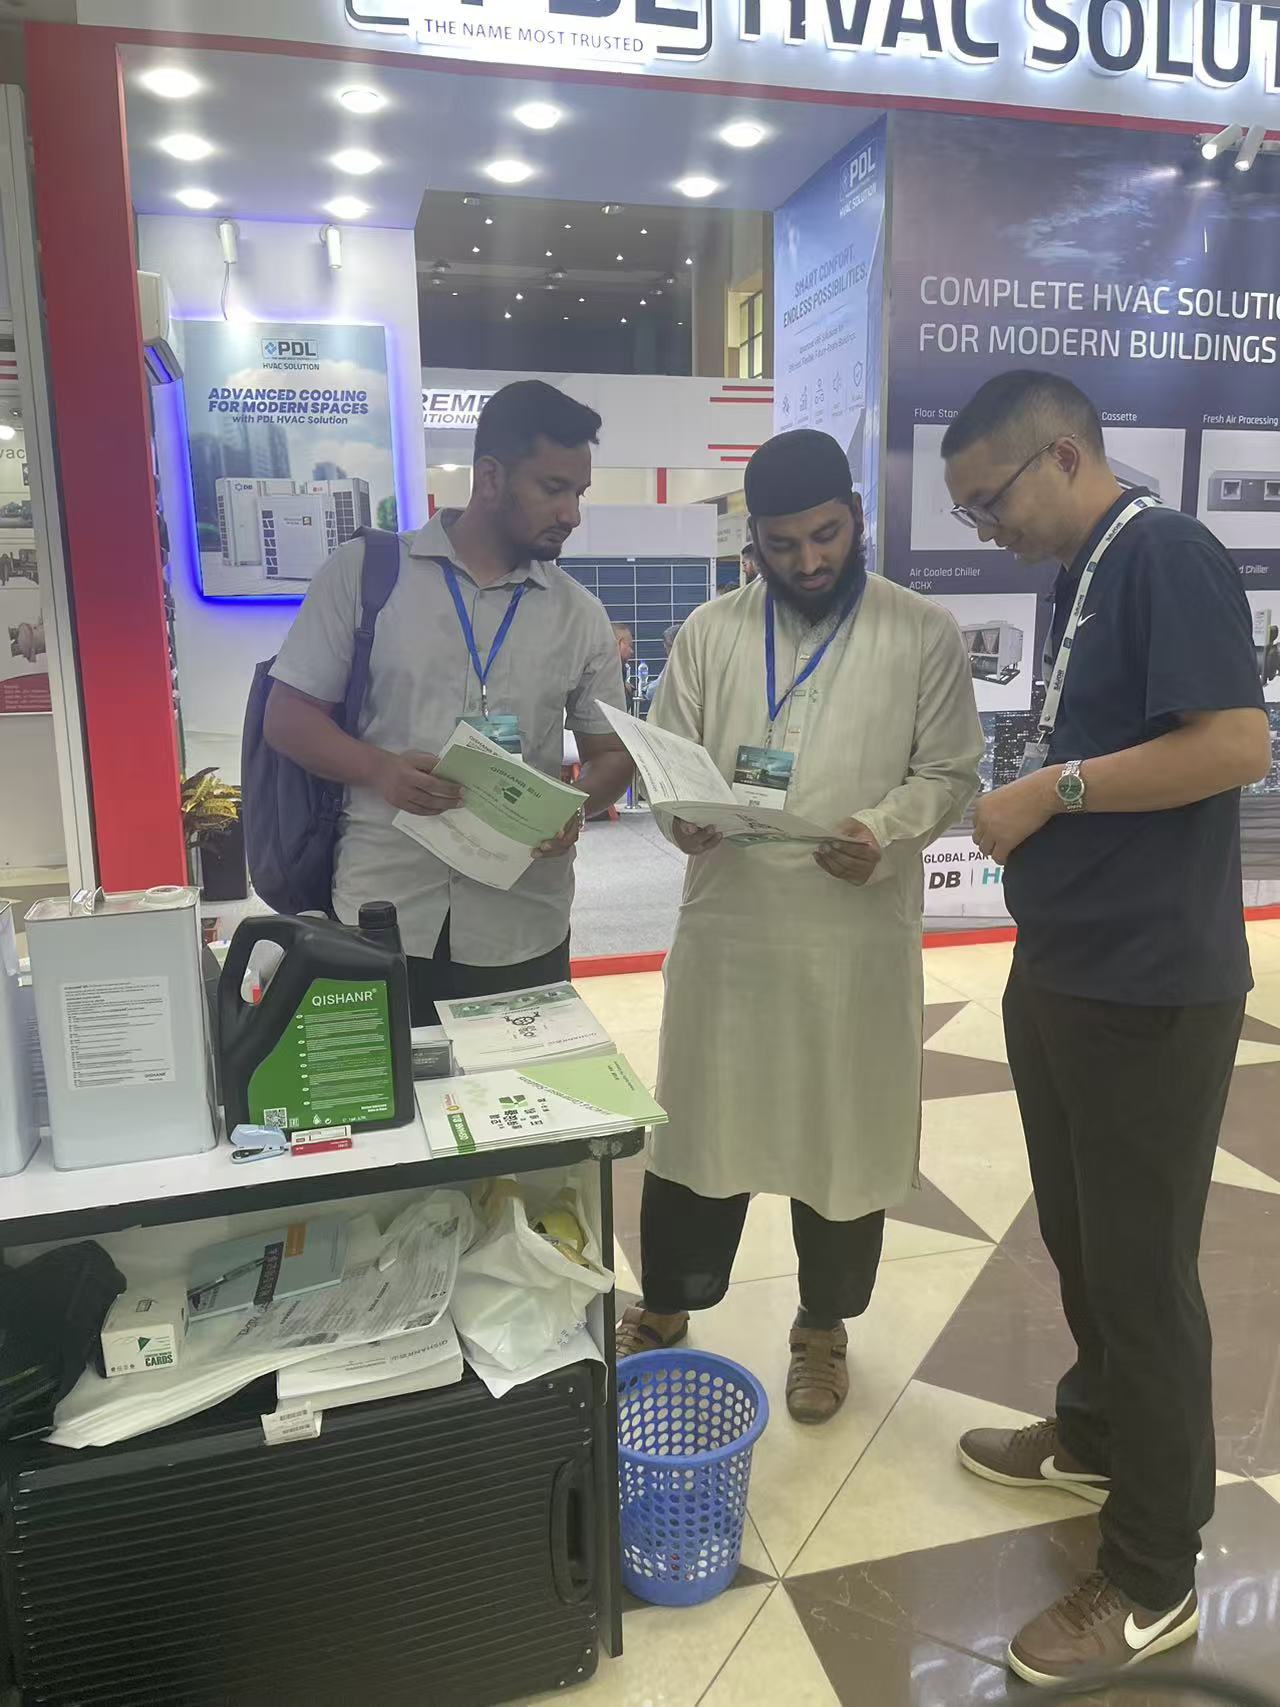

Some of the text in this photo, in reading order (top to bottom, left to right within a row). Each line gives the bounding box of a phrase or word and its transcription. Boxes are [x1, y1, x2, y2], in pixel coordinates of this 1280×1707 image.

[424, 18, 644, 53] THE NAME MOST TRUSTED
[849, 147, 876, 187] PDL
[795, 268, 818, 298] SMART
[920, 275, 1280, 320] COMPLETE HVAC SOLUTI
[783, 295, 812, 328] ENDLESS
[278, 341, 317, 356] PDL
[919, 323, 1277, 364] FOR MODERN BUILDINGS
[262, 362, 320, 371] HVAC SOLUTION
[208, 388, 367, 402] ADVANCED COOLING
[208, 401, 369, 415] FOR MODERN SPACES
[914, 408, 936, 418] Floor
[232, 415, 348, 425] with PDL HVAC Solution
[1101, 411, 1138, 421] Cassette
[1203, 414, 1279, 427] Fresh Air Processing
[909, 567, 981, 577] Air Cooled Chiller
[909, 581, 933, 590] ACHX
[924, 853, 966, 864] GLOBAL
[928, 871, 961, 889] DB
[145, 1354, 174, 1367] CARDS
